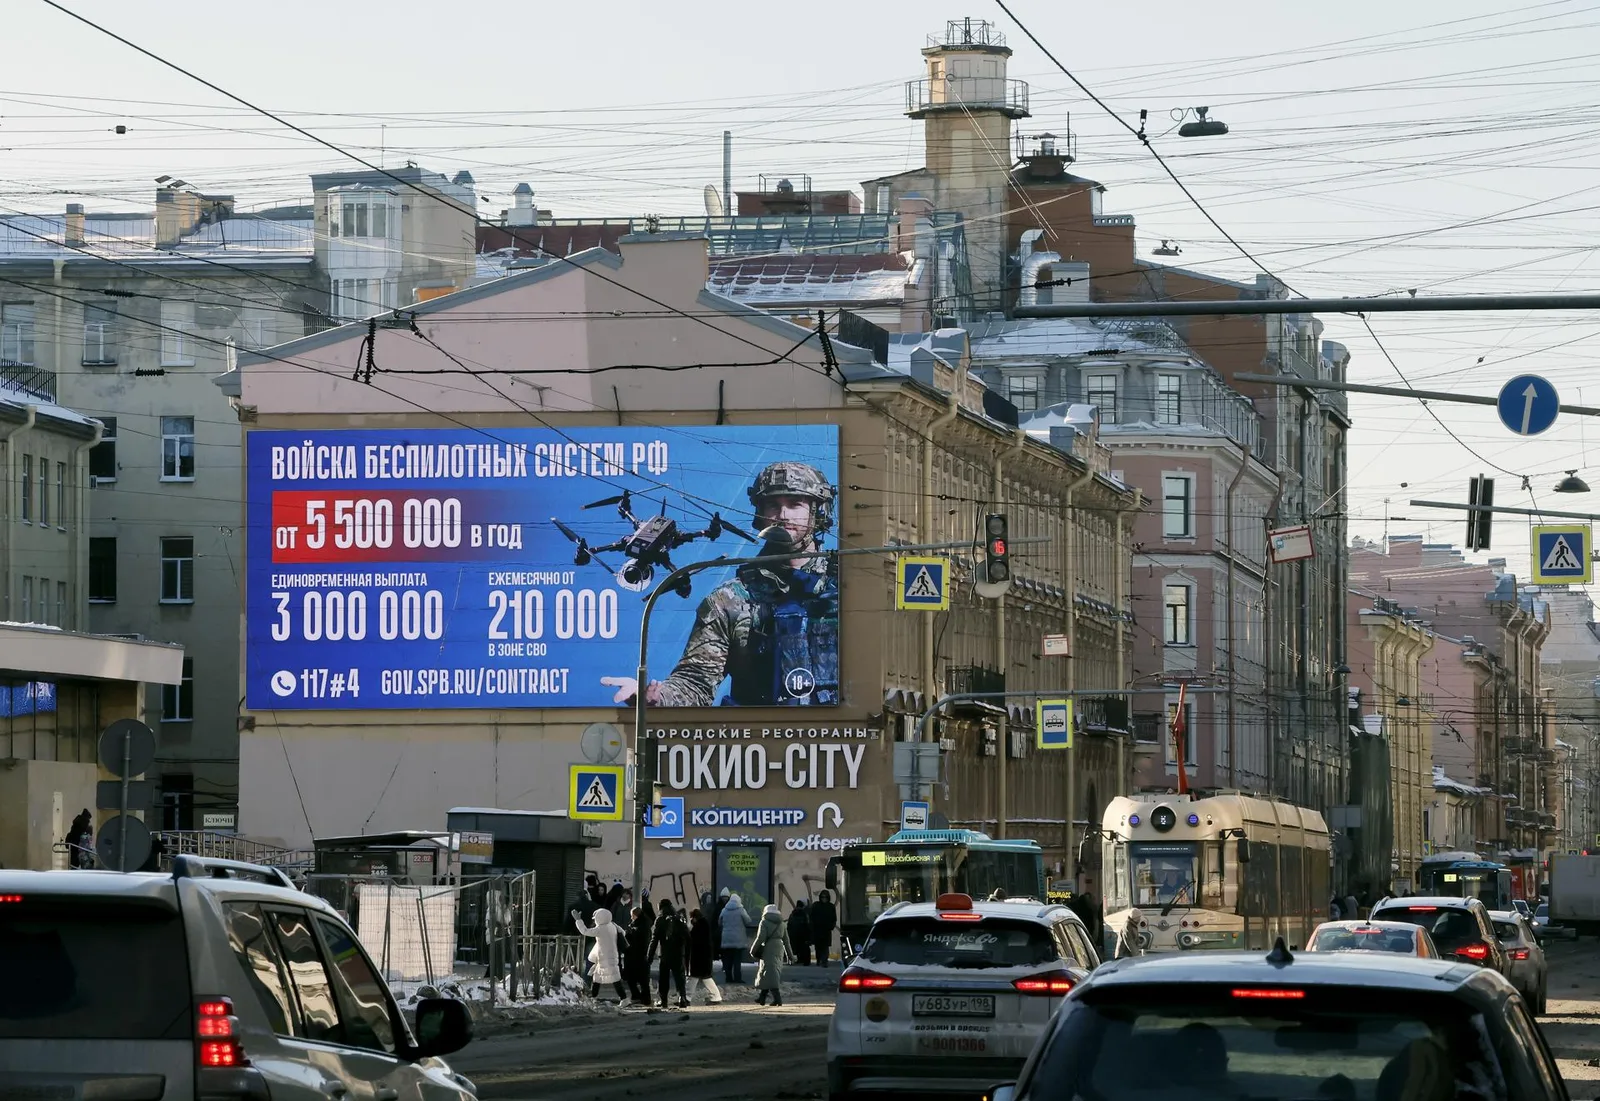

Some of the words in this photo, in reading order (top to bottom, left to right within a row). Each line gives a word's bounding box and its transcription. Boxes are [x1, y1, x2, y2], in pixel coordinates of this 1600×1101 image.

[271, 438, 358, 481] ВОЙСКА
[364, 443, 527, 479] БЕСПИЛОТНЫХ
[534, 442, 624, 478] СИСТЕМ
[632, 440, 669, 477] РФ
[306, 500, 326, 549] 5
[334, 498, 393, 549] 500
[403, 498, 462, 548] 000
[271, 573, 372, 589] ЕДИНОВРЕМЕННАЯ
[374, 572, 428, 588] ВЫПЛАТА
[488, 571, 560, 587] ЕЖЕМЕСЯЧНО
[562, 571, 576, 585] ОТ
[271, 592, 291, 641] 3
[303, 590, 367, 641] 000
[379, 590, 443, 640] 000
[488, 589, 544, 640] 210
[555, 588, 618, 639] 000
[488, 643, 496, 657] В
[498, 643, 524, 657] ЗОНЕ
[526, 642, 547, 656] СВО
[300, 668, 360, 698] 117#4
[381, 667, 569, 696] GOV.SPB.RU/CONTRACT
[792, 675, 810, 690] 18+
[646, 727, 751, 740] ГОРОДСКИЕ
[762, 727, 867, 739] РЕСТОРАНЫ
[691, 810, 805, 827] КОПИЦЕНТР
